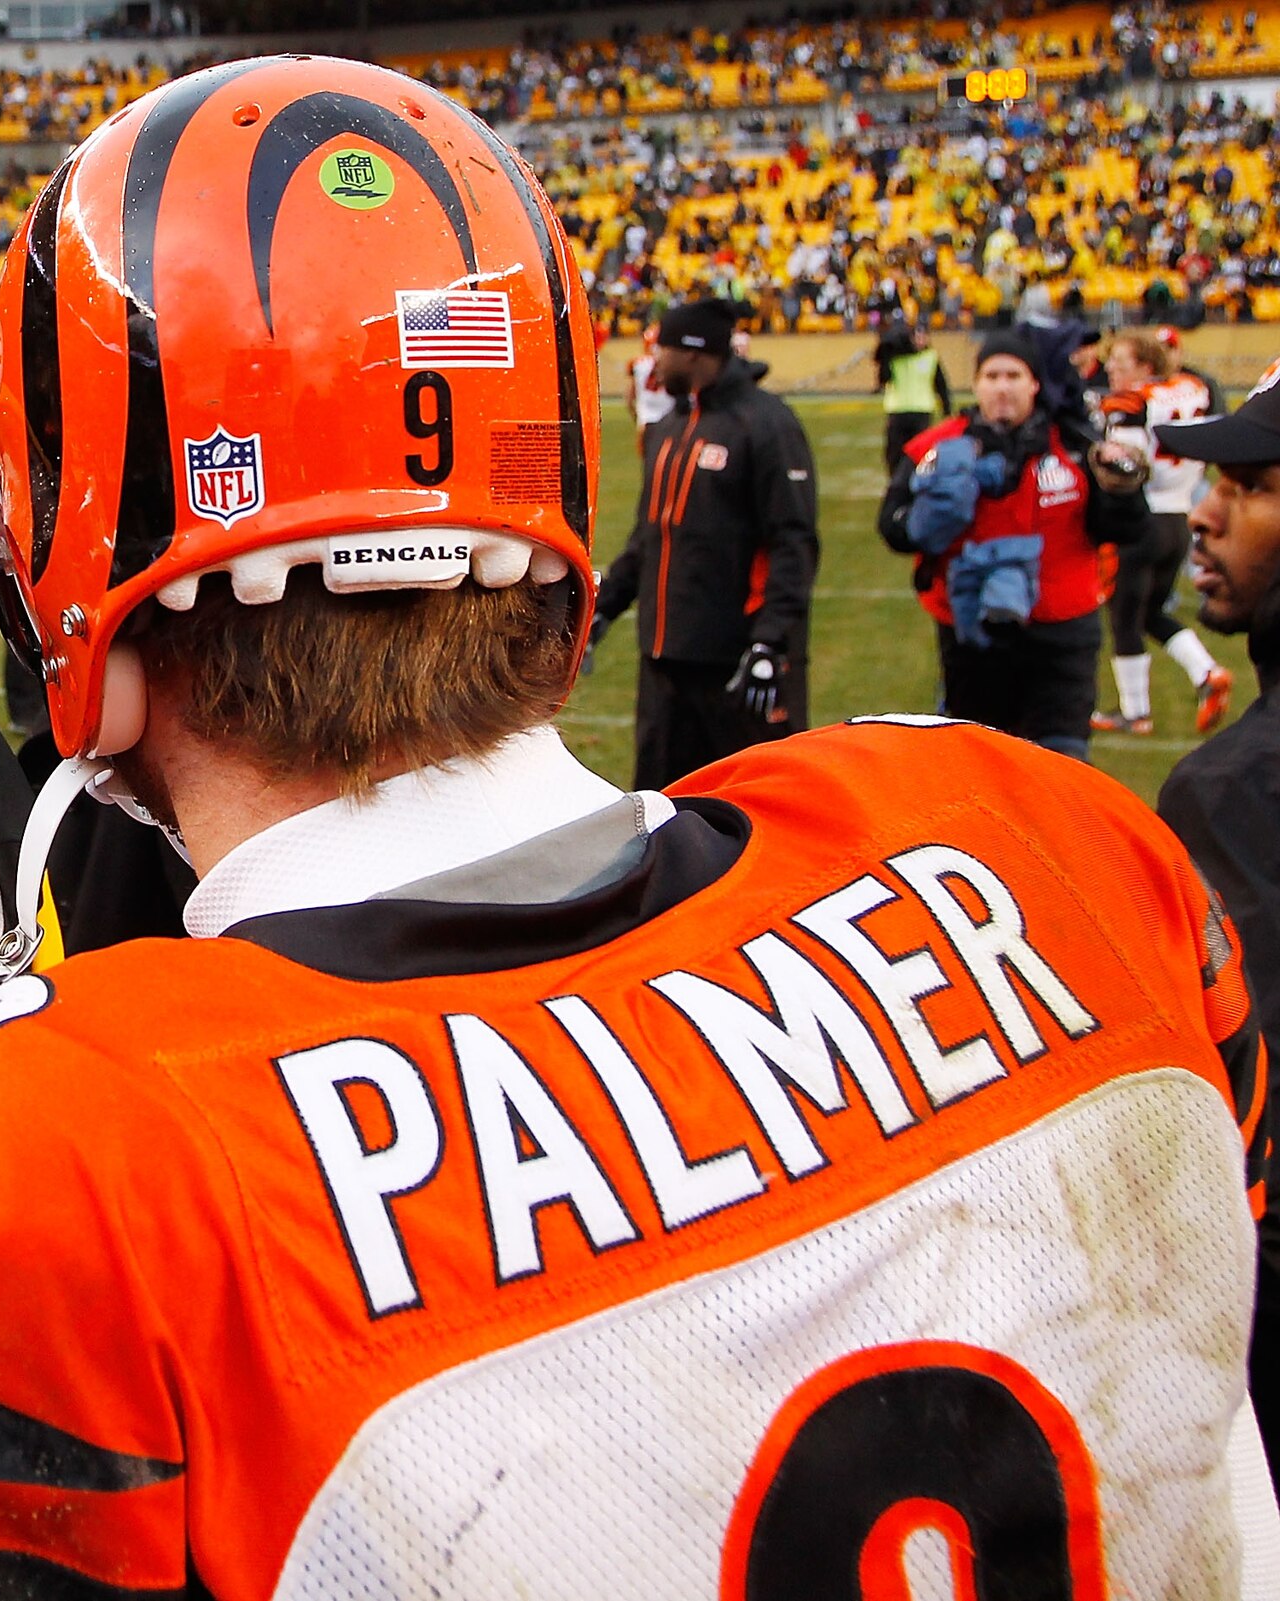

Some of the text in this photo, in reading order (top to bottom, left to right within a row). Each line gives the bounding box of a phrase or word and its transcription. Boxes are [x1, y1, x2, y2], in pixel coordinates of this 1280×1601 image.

[342, 167, 372, 184] NFL
[403, 370, 454, 487] 9
[196, 470, 252, 511] NFL
[333, 546, 468, 565] BENGALS
[272, 844, 1102, 1321] PALMER
